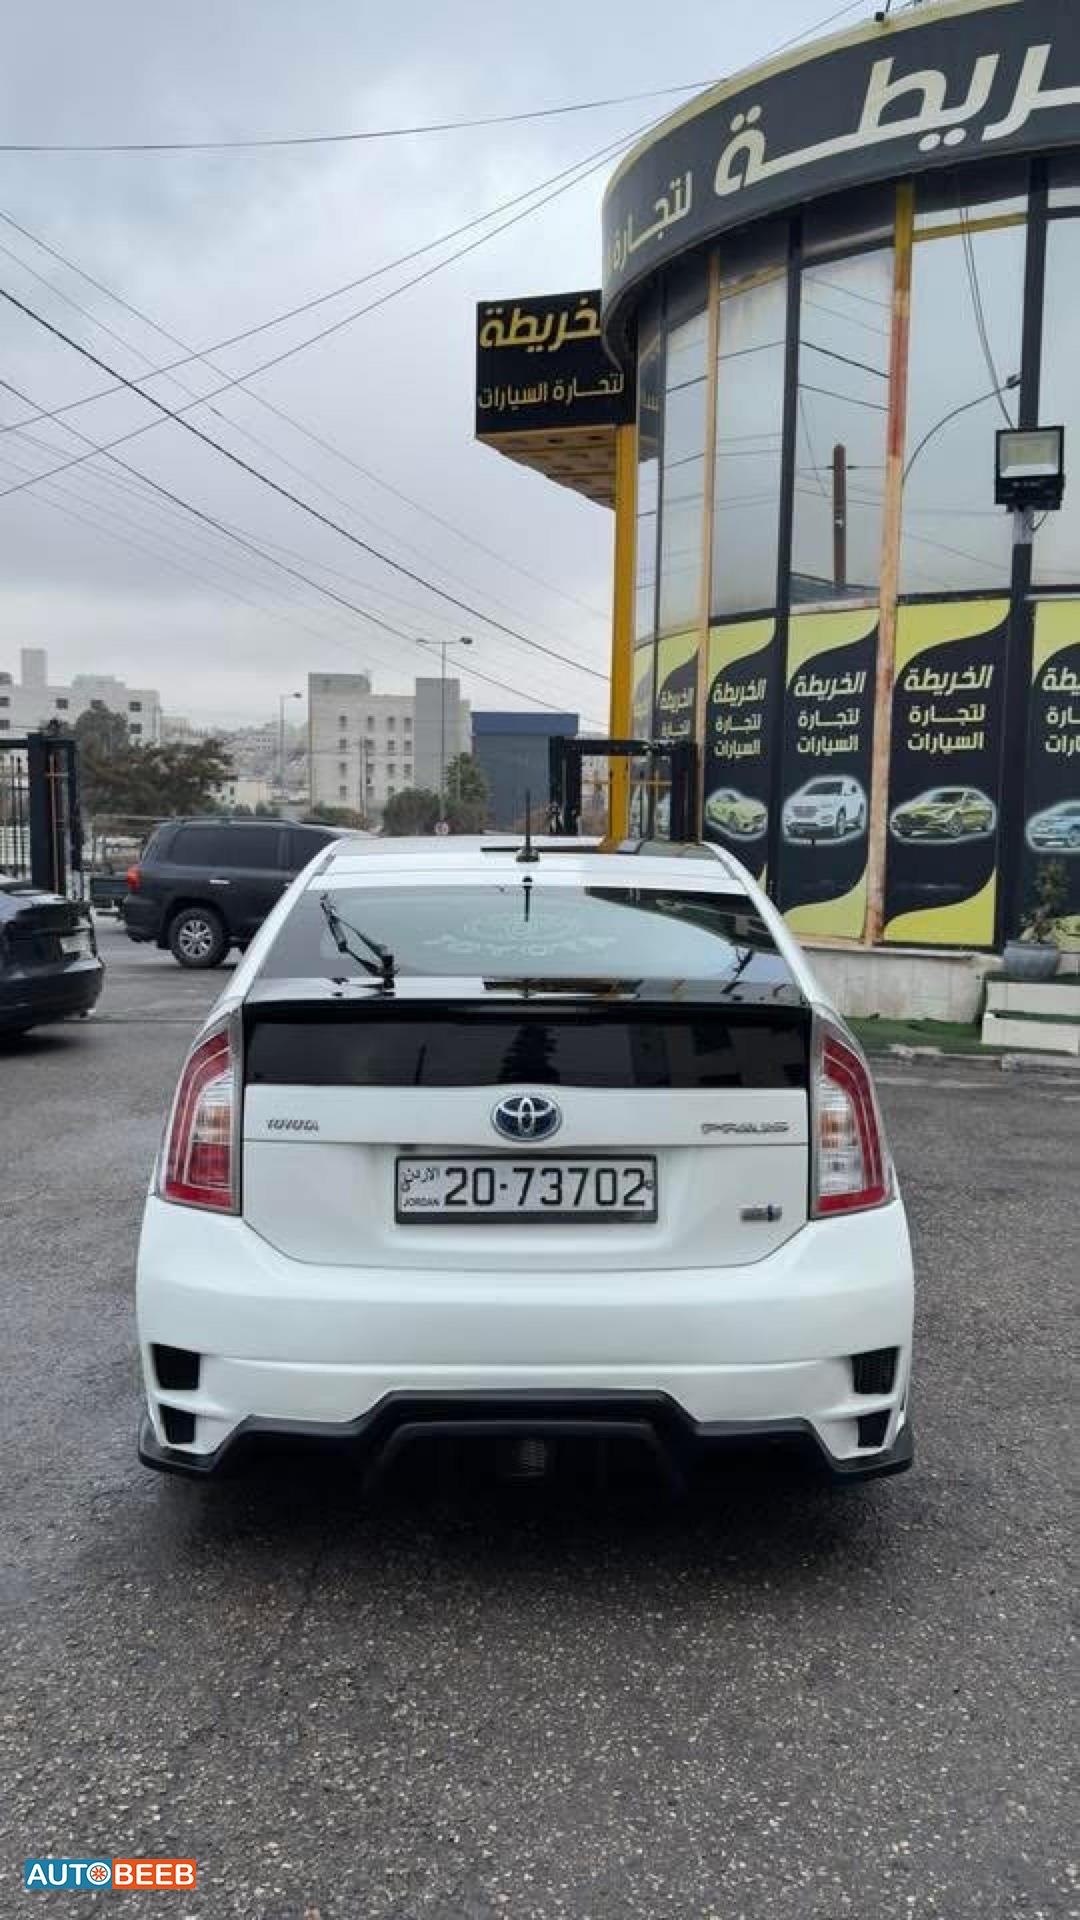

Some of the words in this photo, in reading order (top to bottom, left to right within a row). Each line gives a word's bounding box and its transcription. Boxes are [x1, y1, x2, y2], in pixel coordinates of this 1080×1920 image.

[713, 44, 1080, 196] ريطة
[480, 296, 601, 352] خريطة
[479, 380, 547, 411] السيارات
[713, 677, 767, 706] الخريطة
[794, 671, 866, 701] الخريطة
[904, 664, 994, 696] الخريطة
[715, 713, 761, 734] لتجارة
[797, 707, 859, 730] لتجارة
[908, 703, 986, 726] لتجارة
[714, 738, 760, 758] السيارات
[797, 735, 858, 756] السيارات
[907, 732, 985, 754] السيارات
[266, 1119, 319, 1131] TOYOTA
[445, 1167, 645, 1206] 20-73702
